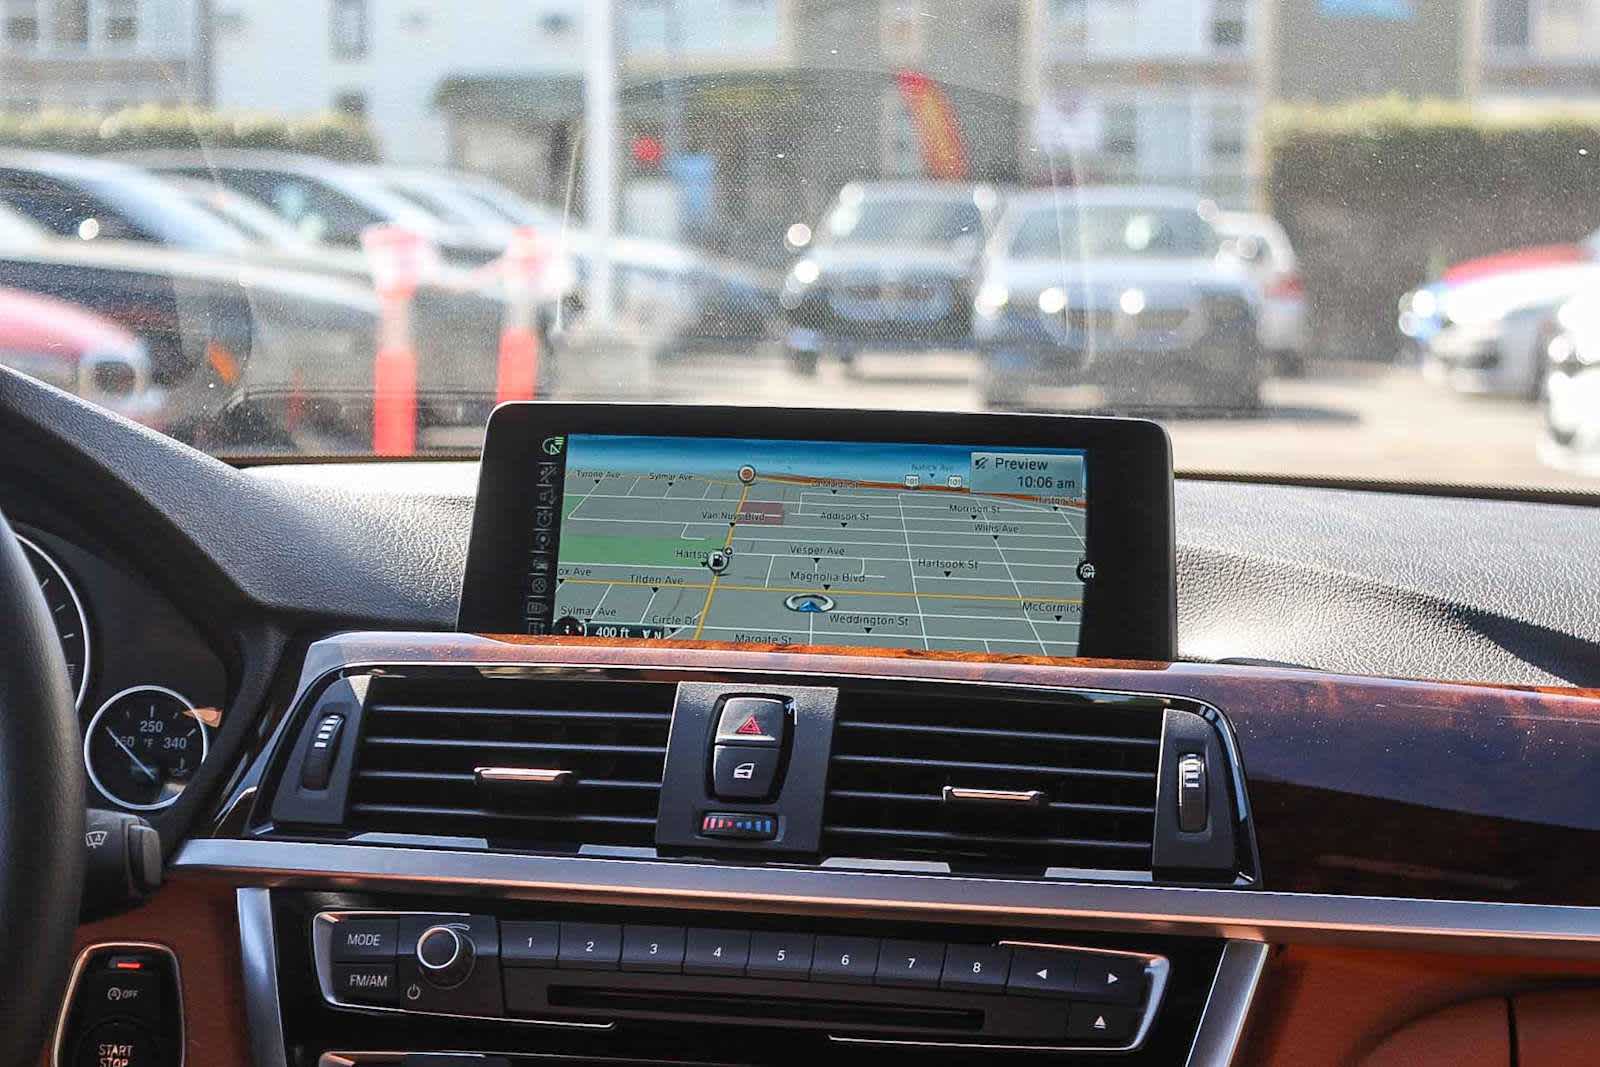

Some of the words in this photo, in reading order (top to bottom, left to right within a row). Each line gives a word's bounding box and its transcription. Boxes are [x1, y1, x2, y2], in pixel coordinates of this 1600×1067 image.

[995, 457, 1049, 470] Preview
[649, 472, 676, 481] Sylmar
[678, 473, 693, 481] Ave
[1017, 476, 1053, 489] 10:06
[1056, 479, 1075, 489] am
[949, 503, 989, 513] Morrison
[991, 505, 1000, 514] St
[701, 511, 718, 520] Van
[820, 511, 858, 521] Addison
[860, 512, 871, 521] St
[1001, 523, 1019, 533] Ave
[790, 545, 823, 555] Vesper
[826, 546, 845, 555] Ave
[918, 558, 964, 569] Hartsook
[967, 560, 978, 569] St
[573, 569, 592, 577] Ave
[790, 571, 839, 583] Magnolia
[842, 573, 866, 583] Blvd
[629, 574, 661, 585] Tilden
[664, 576, 684, 585] Ave
[560, 606, 594, 618] Sylmar
[599, 607, 616, 616] Ave
[1022, 601, 1081, 613] McCormick
[652, 615, 682, 625] Circle
[684, 617, 697, 625] Dr
[829, 613, 895, 627] Weddington
[897, 616, 909, 626] St
[595, 626, 618, 638] 400
[620, 627, 631, 638] ft
[780, 634, 792, 645] St
[139, 720, 163, 732] 250
[163, 736, 187, 749] 340
[347, 933, 381, 947] MODE
[526, 938, 533, 948] 1
[586, 941, 595, 952] 2
[650, 943, 658, 955] 3
[713, 946, 722, 958] 4
[776, 949, 785, 962] 5
[841, 954, 850, 966] 6
[907, 957, 916, 969] 7
[972, 961, 981, 974] 8
[350, 974, 388, 988] FM/AM
[122, 990, 139, 999] OFF
[99, 1043, 134, 1057] START
[99, 1057, 130, 1067] STOP
